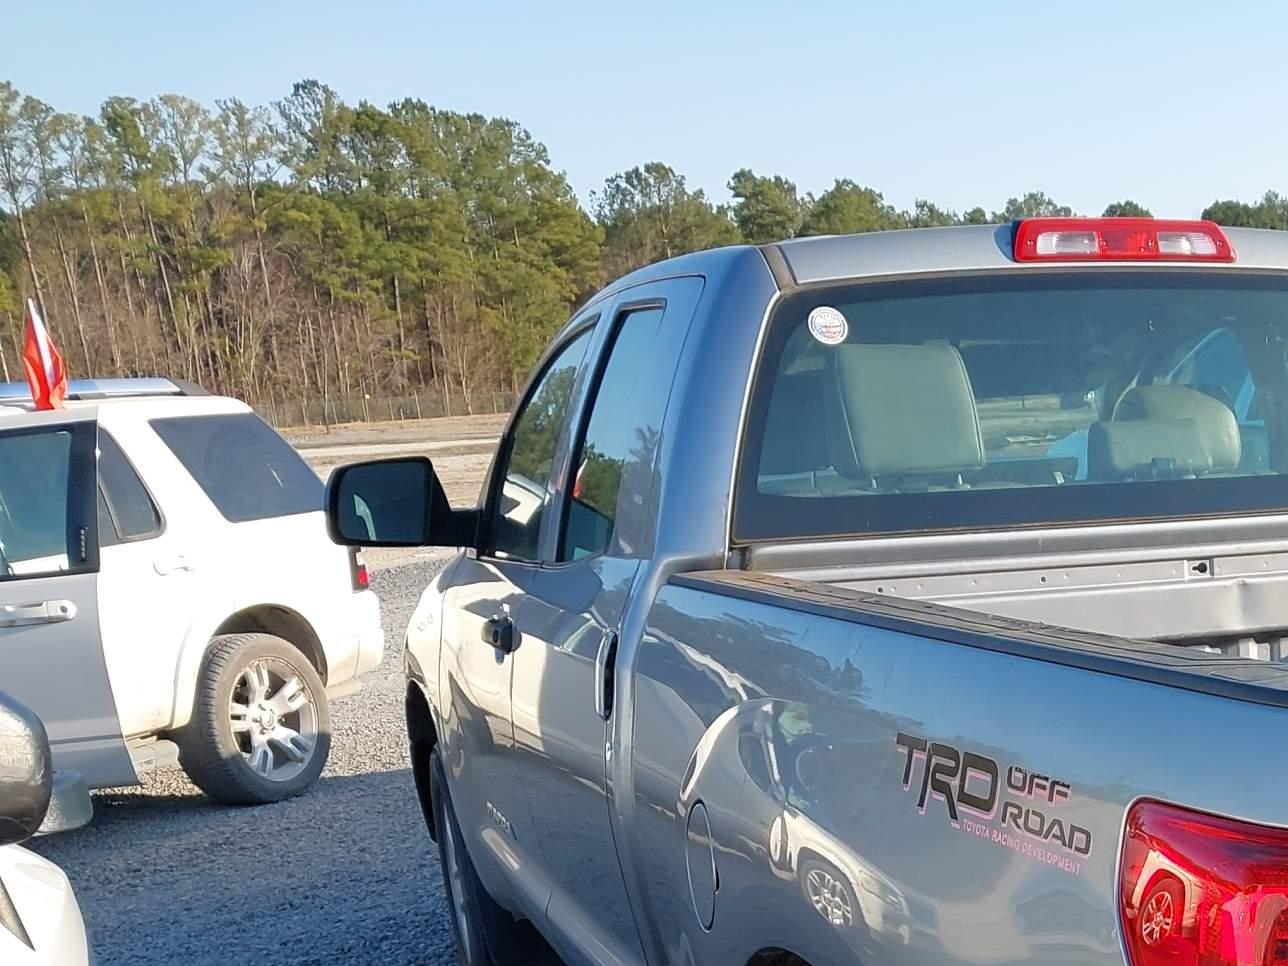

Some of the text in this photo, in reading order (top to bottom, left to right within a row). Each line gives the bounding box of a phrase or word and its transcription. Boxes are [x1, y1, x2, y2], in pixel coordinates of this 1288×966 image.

[896, 731, 999, 827] TRD
[1006, 765, 1071, 804] OFF
[962, 819, 1081, 876] TOYOTA RACING DEVELOPMENT
[1001, 800, 1093, 858] ROAD
